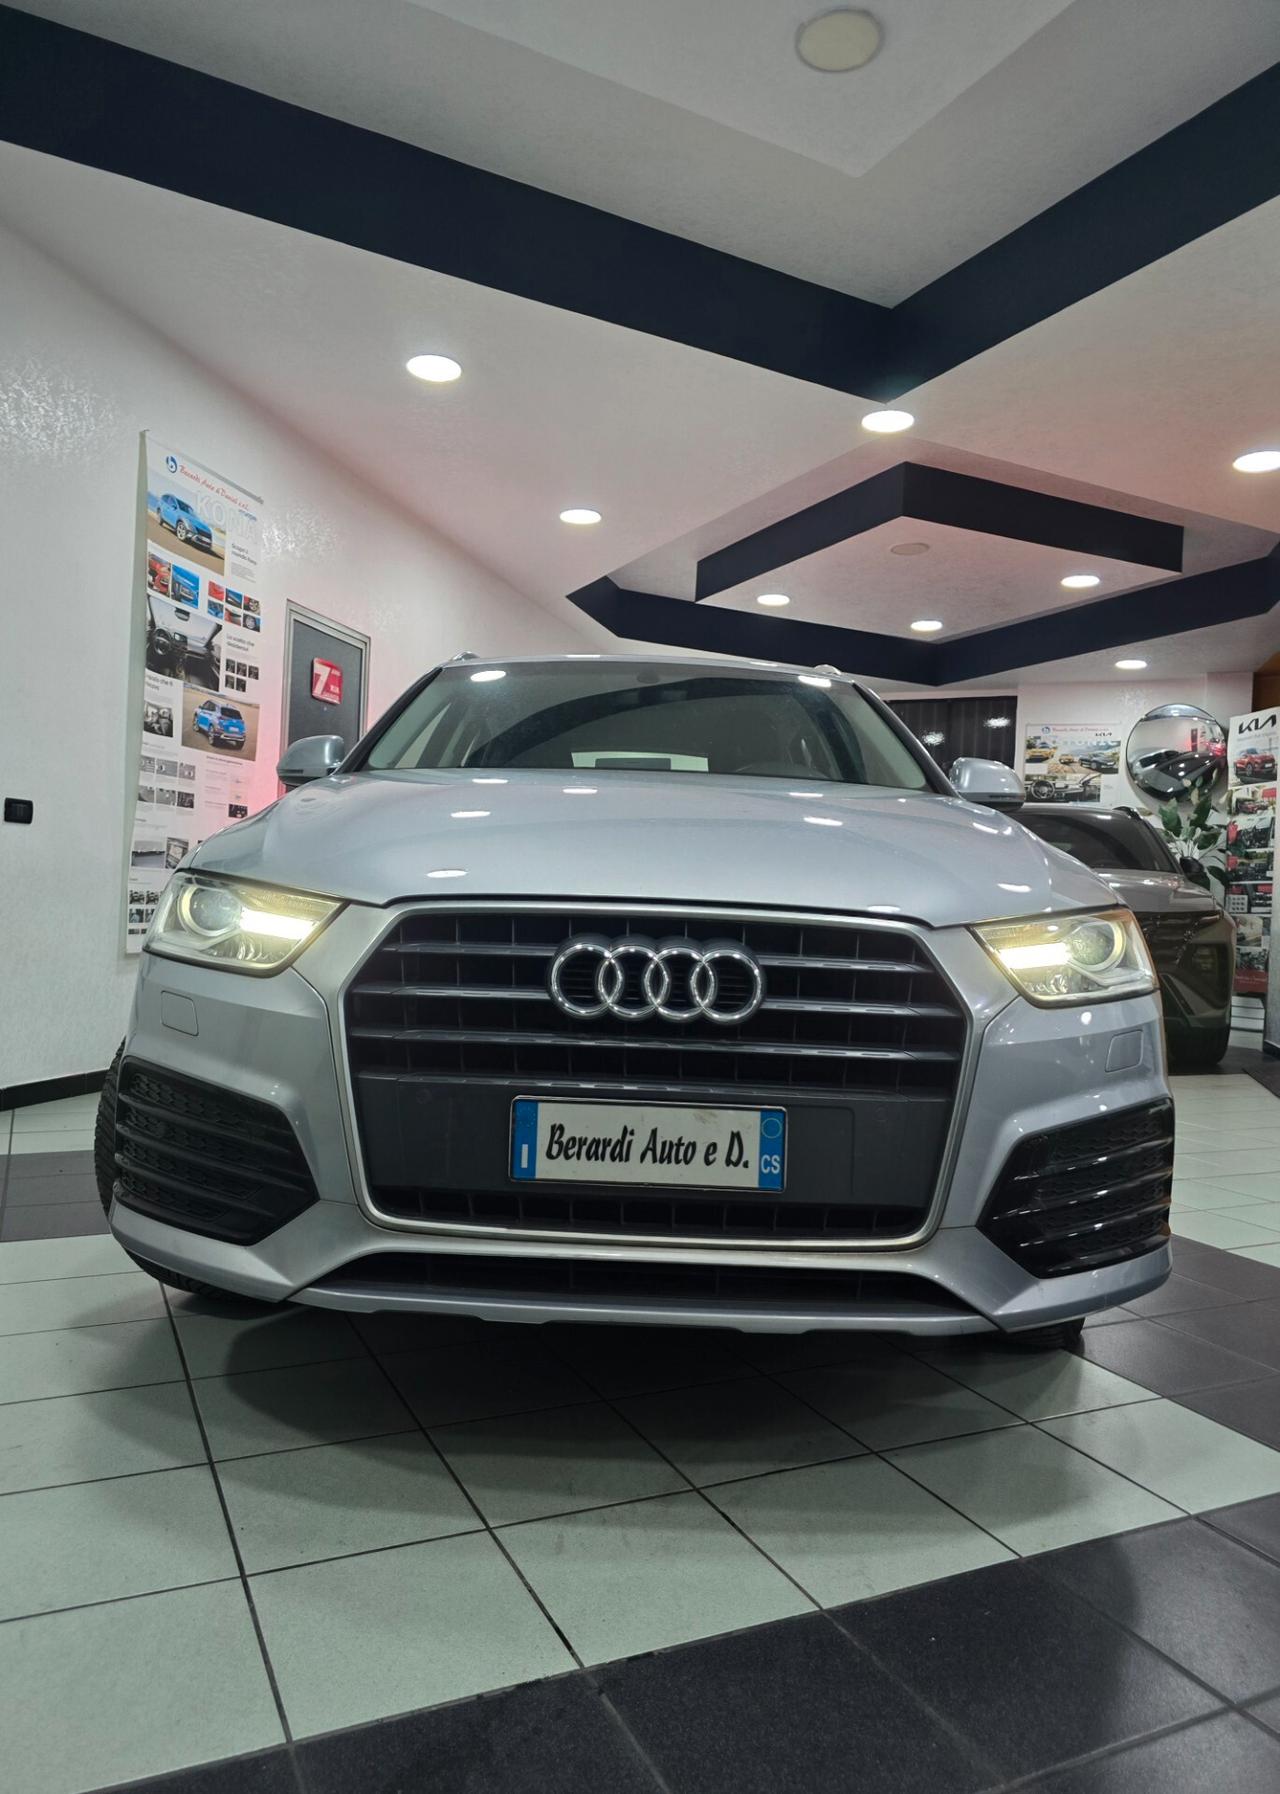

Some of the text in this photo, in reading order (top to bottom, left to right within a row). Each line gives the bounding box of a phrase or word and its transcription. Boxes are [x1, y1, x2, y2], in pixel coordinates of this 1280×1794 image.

[312, 659, 332, 698] 7
[1238, 714, 1276, 734] KIA
[546, 1123, 749, 1169] Berardi Auto e D.
[761, 1154, 781, 1174] CS
